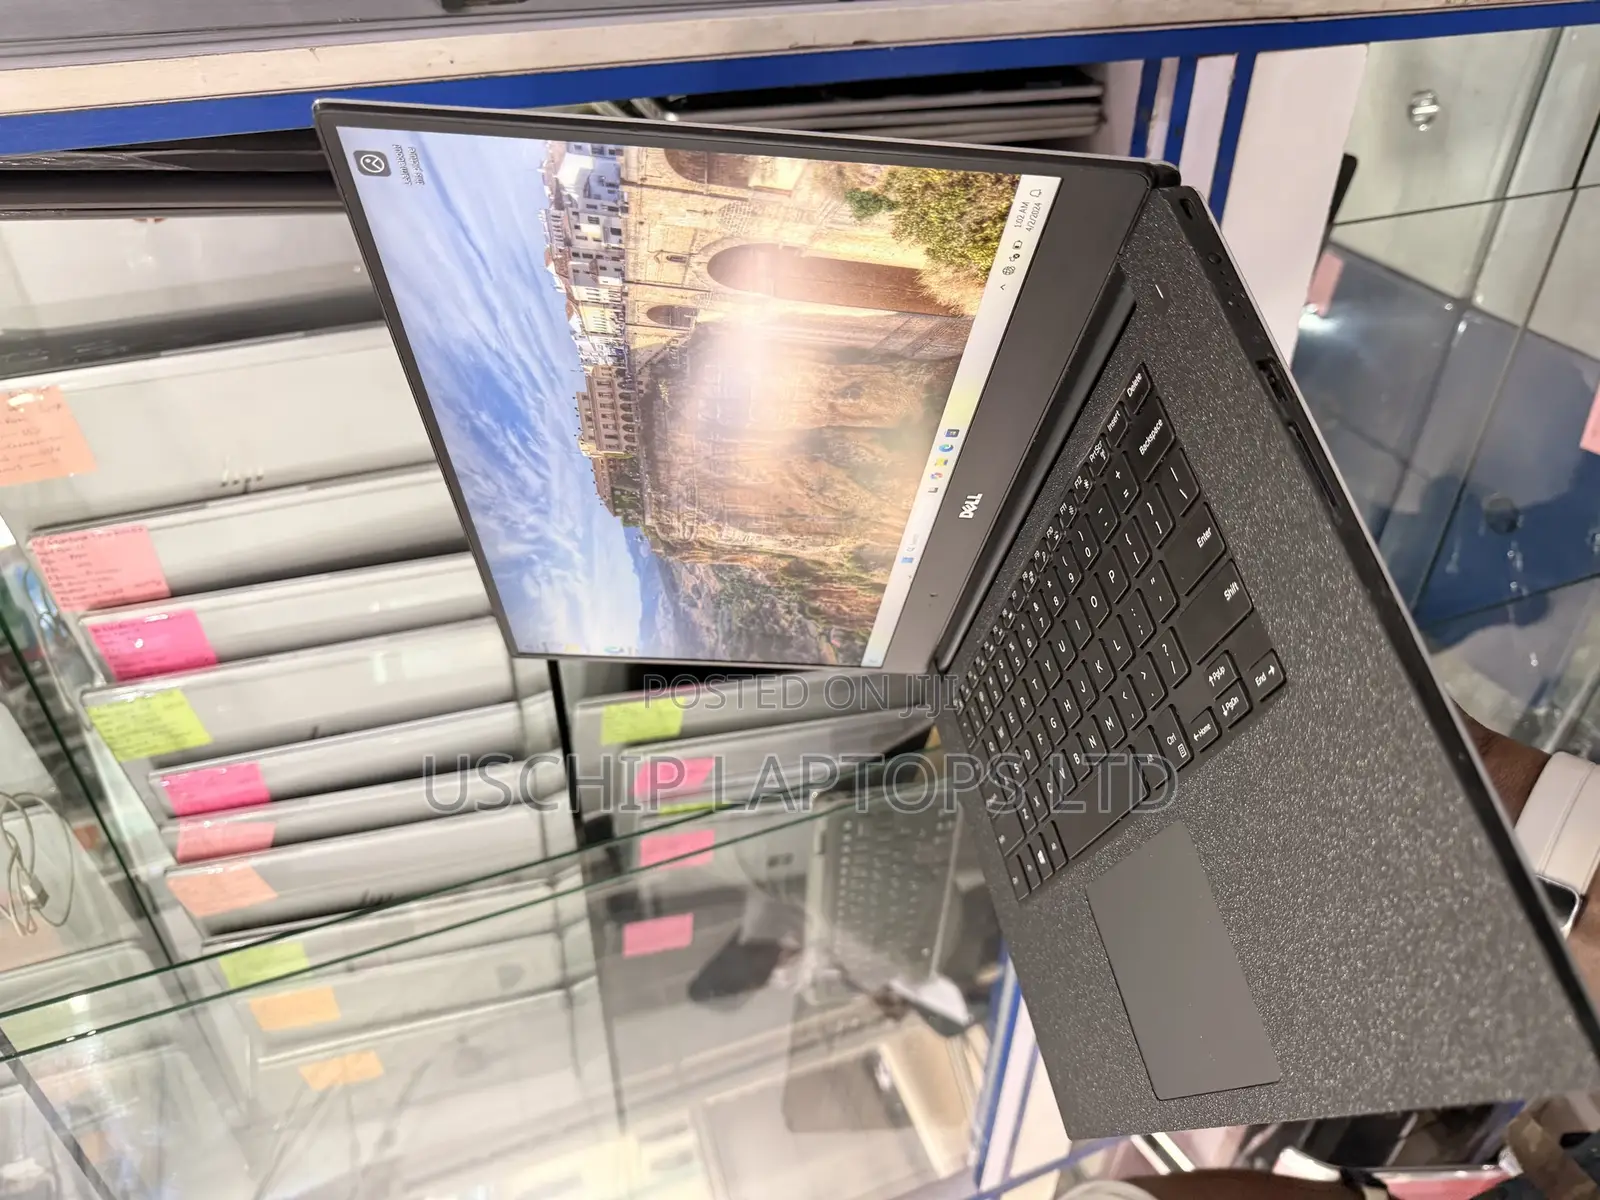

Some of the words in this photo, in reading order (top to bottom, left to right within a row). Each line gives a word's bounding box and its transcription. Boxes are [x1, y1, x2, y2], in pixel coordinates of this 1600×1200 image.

[1014, 212, 1024, 228] 1:02
[1019, 201, 1029, 214] AM
[1026, 202, 1042, 232] 4/2/2024
[1127, 373, 1142, 397] Delete
[1107, 410, 1120, 432] Insert
[1139, 419, 1163, 455] Backspace
[1090, 441, 1103, 462] PrtScr
[1116, 471, 1120, 479] +
[1074, 476, 1082, 489] F12
[1123, 489, 1128, 498] =
[959, 493, 983, 518] DELL
[1196, 527, 1212, 547] Enter
[1085, 547, 1090, 558] 0
[1068, 572, 1074, 583] 9
[1108, 570, 1115, 583] P
[1224, 581, 1239, 601] Shift
[1053, 596, 1058, 606] 8
[1091, 596, 1097, 608] O
[1039, 617, 1044, 627] 7
[1075, 620, 1080, 630] I
[1026, 638, 1032, 648] 6
[1059, 640, 1065, 652] U
[1113, 640, 1121, 651] L
[1162, 644, 1169, 656] ?
[1015, 657, 1020, 666] 5
[1045, 660, 1051, 671] Y
[1095, 660, 1103, 673] K
[1004, 674, 1008, 682] 4
[1212, 666, 1225, 680] PgUp
[1032, 679, 1038, 690] T
[1255, 673, 1266, 687] End
[1081, 681, 1086, 693] J
[1020, 697, 1026, 708] R
[1064, 700, 1071, 712] H
[1225, 696, 1239, 711] PgDn
[1009, 712, 1014, 723] E
[1050, 718, 1057, 728] G
[1105, 716, 1114, 731] M
[1198, 723, 1211, 737] Home
[1037, 733, 1043, 745] F
[1089, 735, 1096, 748] N
[1166, 733, 1176, 745] Ctrl
[1025, 750, 1031, 760] D
[1074, 753, 1080, 764] B
[1014, 763, 1019, 774] S
[1059, 768, 1066, 779] V
[1033, 796, 1040, 807] X
[1022, 808, 1029, 820] Z
